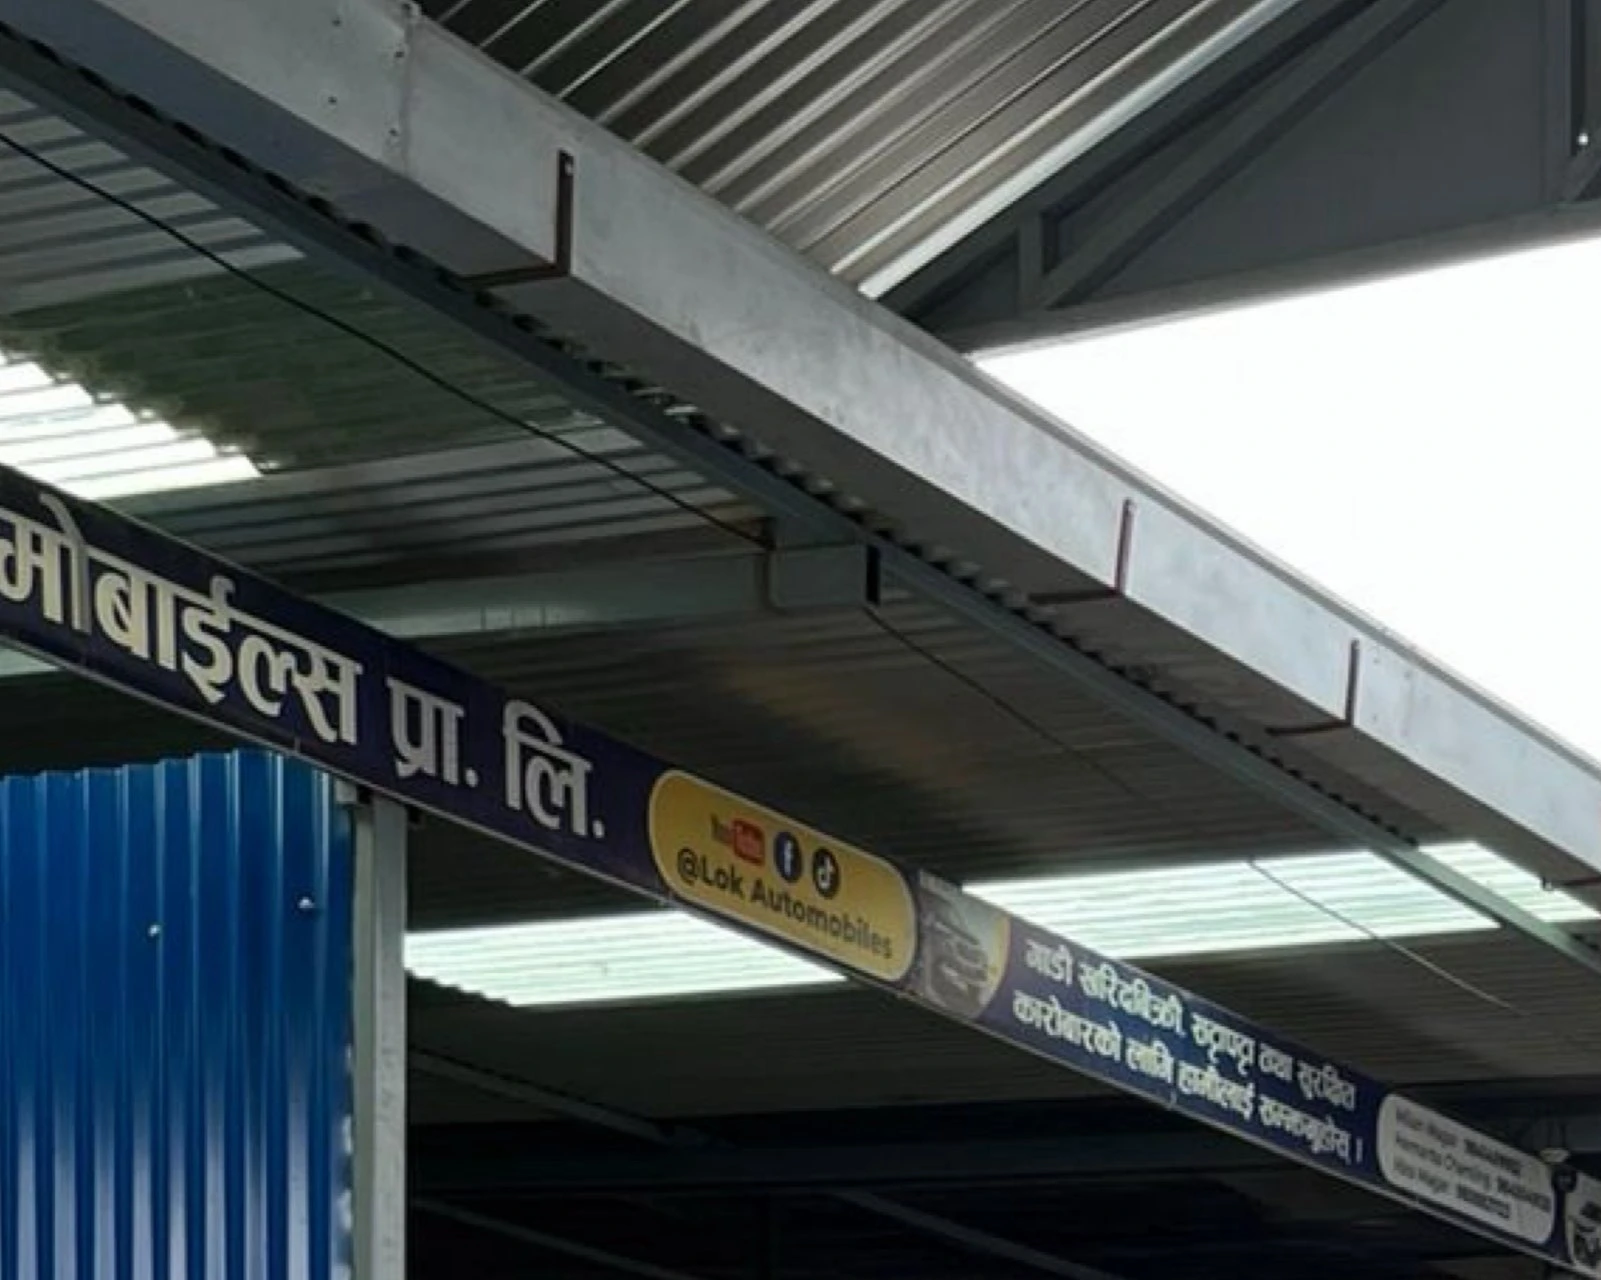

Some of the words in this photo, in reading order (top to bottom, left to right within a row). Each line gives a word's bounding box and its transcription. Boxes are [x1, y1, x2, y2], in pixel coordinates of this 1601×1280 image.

[386, 675, 479, 788] प्रा.
[502, 698, 606, 840] लि.
[676, 847, 746, 899] @Lok
[750, 878, 894, 960] Automobiles
